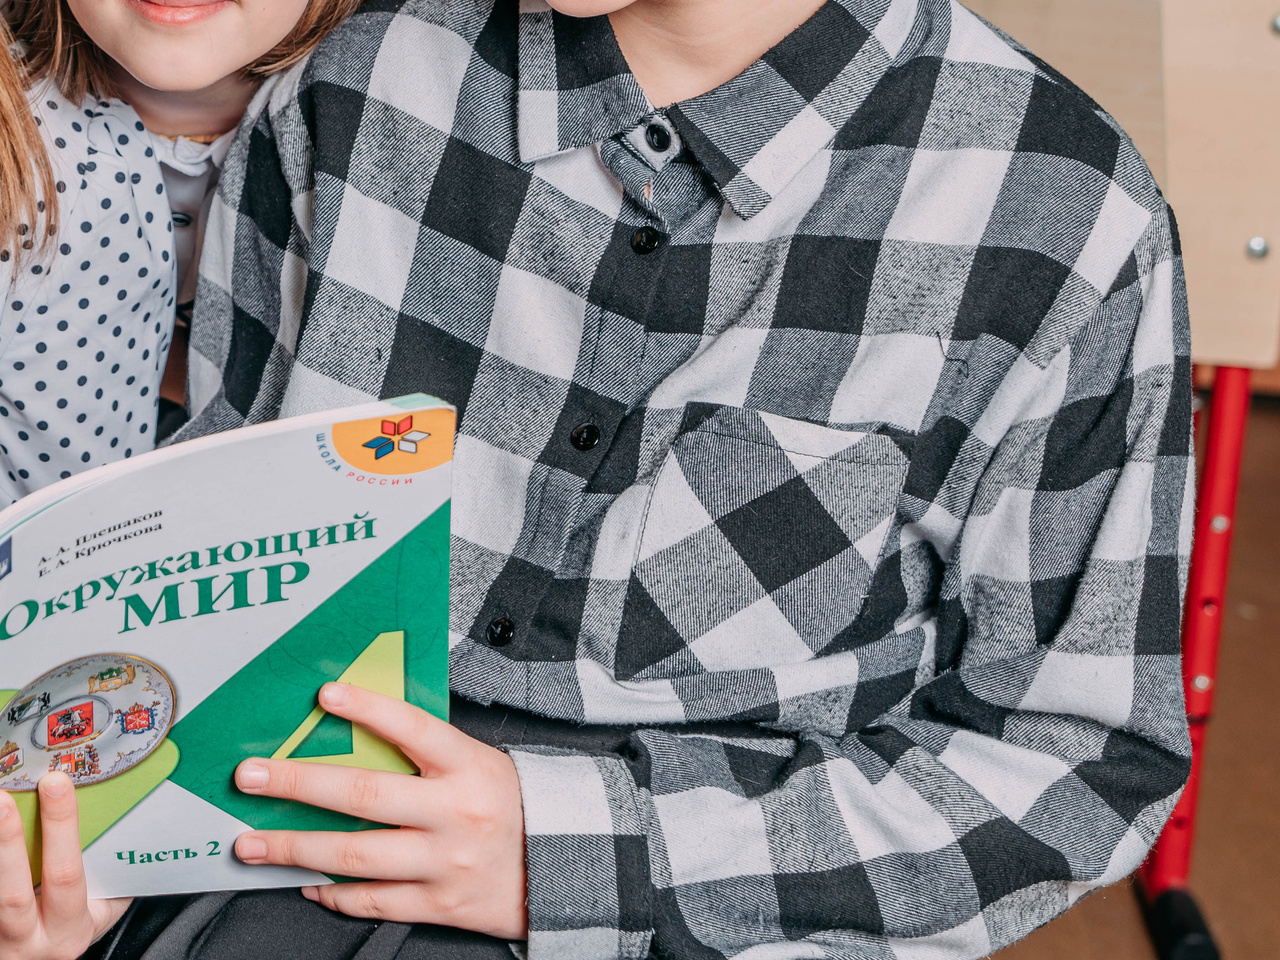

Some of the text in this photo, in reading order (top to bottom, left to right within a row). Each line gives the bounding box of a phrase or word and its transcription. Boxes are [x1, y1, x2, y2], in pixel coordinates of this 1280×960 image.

[316, 432, 413, 486] ШКОЛА РОССИИ
[37, 510, 164, 567] А. А. Плешаков
[38, 522, 164, 578] Е. А. Крючкова
[117, 560, 311, 634] МИР
[116, 840, 222, 867] Часть 2
